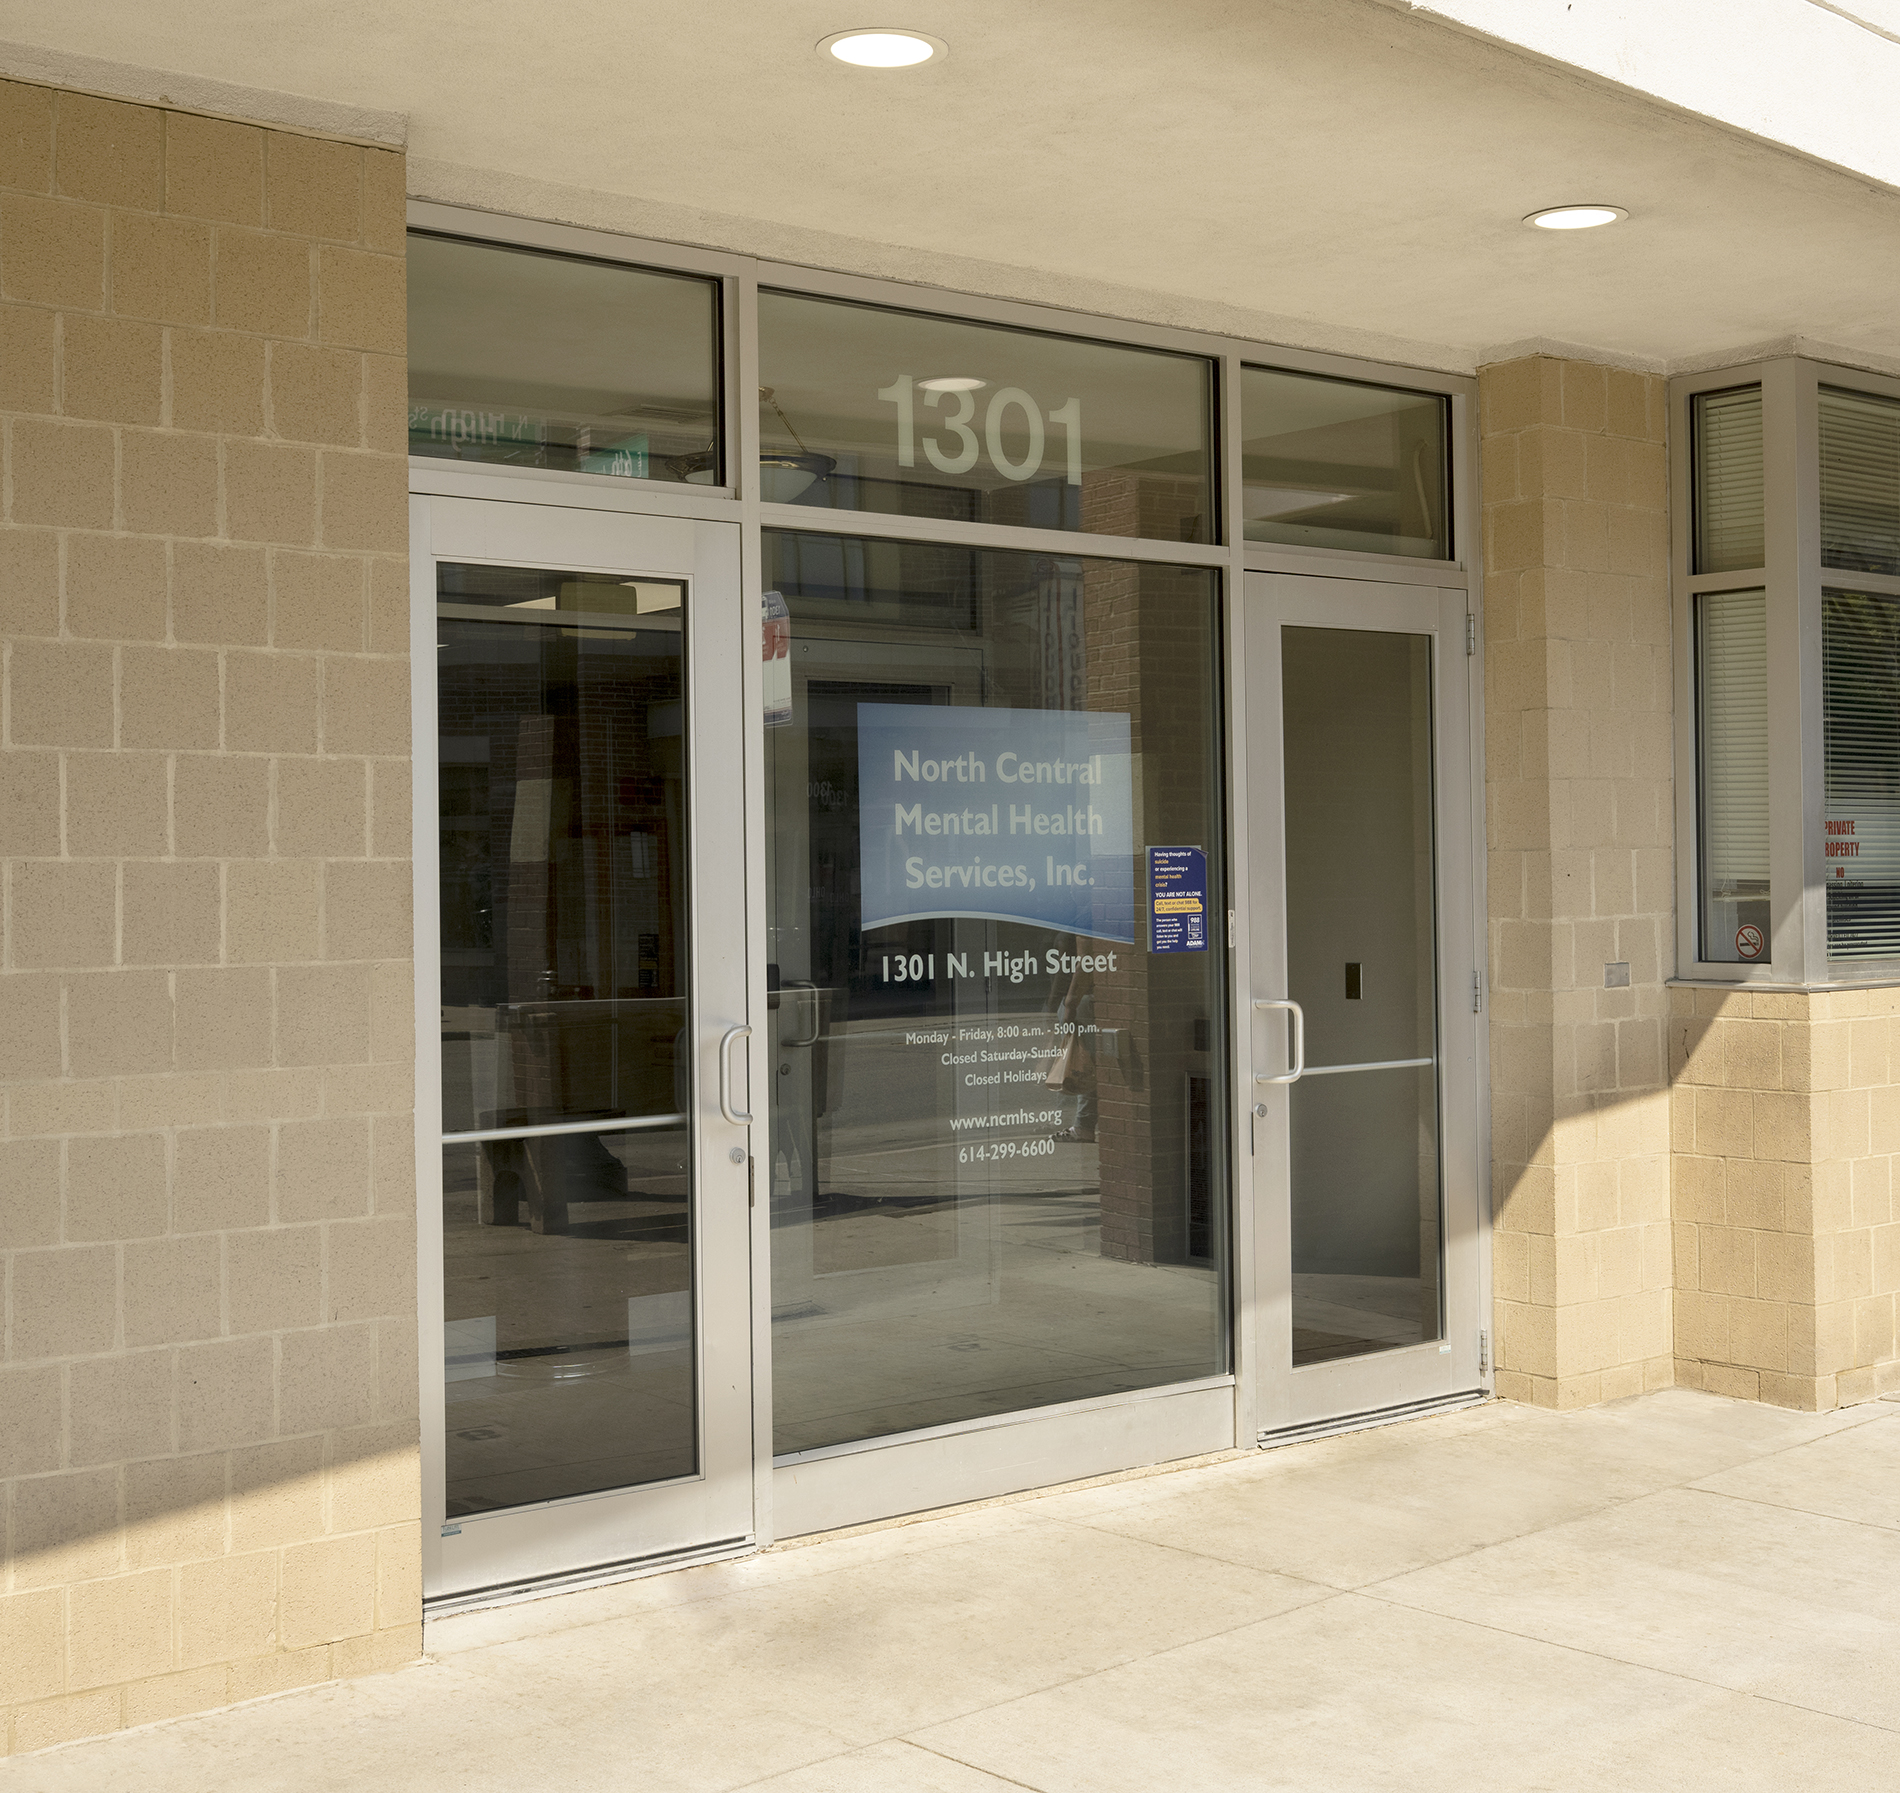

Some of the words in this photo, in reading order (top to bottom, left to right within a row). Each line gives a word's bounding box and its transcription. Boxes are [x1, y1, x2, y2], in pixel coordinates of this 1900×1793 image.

[877, 374, 1083, 486] 1301
[894, 749, 986, 783] North
[995, 751, 1102, 785] Central
[894, 803, 999, 836] Mental
[1009, 804, 1103, 836] Health
[1824, 842, 1860, 856] ROPERTY
[905, 856, 1036, 893] Services,
[1046, 855, 1096, 887] Inc.
[1836, 866, 1844, 878] NO
[881, 953, 935, 983] 1301
[947, 952, 975, 979] N.
[983, 949, 1038, 984] High
[1045, 948, 1118, 975] Street
[905, 1031, 949, 1046] Monday
[959, 1027, 994, 1042] Friday,
[997, 1025, 1019, 1039] 8:00
[1022, 1027, 1045, 1038] a.m.
[1053, 1021, 1076, 1036] 5:00
[1078, 1023, 1100, 1037] p.m.
[941, 1051, 978, 1065] Closed
[980, 1046, 1069, 1063] Saturday-Sunday
[964, 1072, 1001, 1086] Closed
[1003, 1069, 1048, 1085] Holidays
[949, 1108, 1063, 1131] www.ncmhs.org
[958, 1138, 1056, 1164] 614-299-6600
